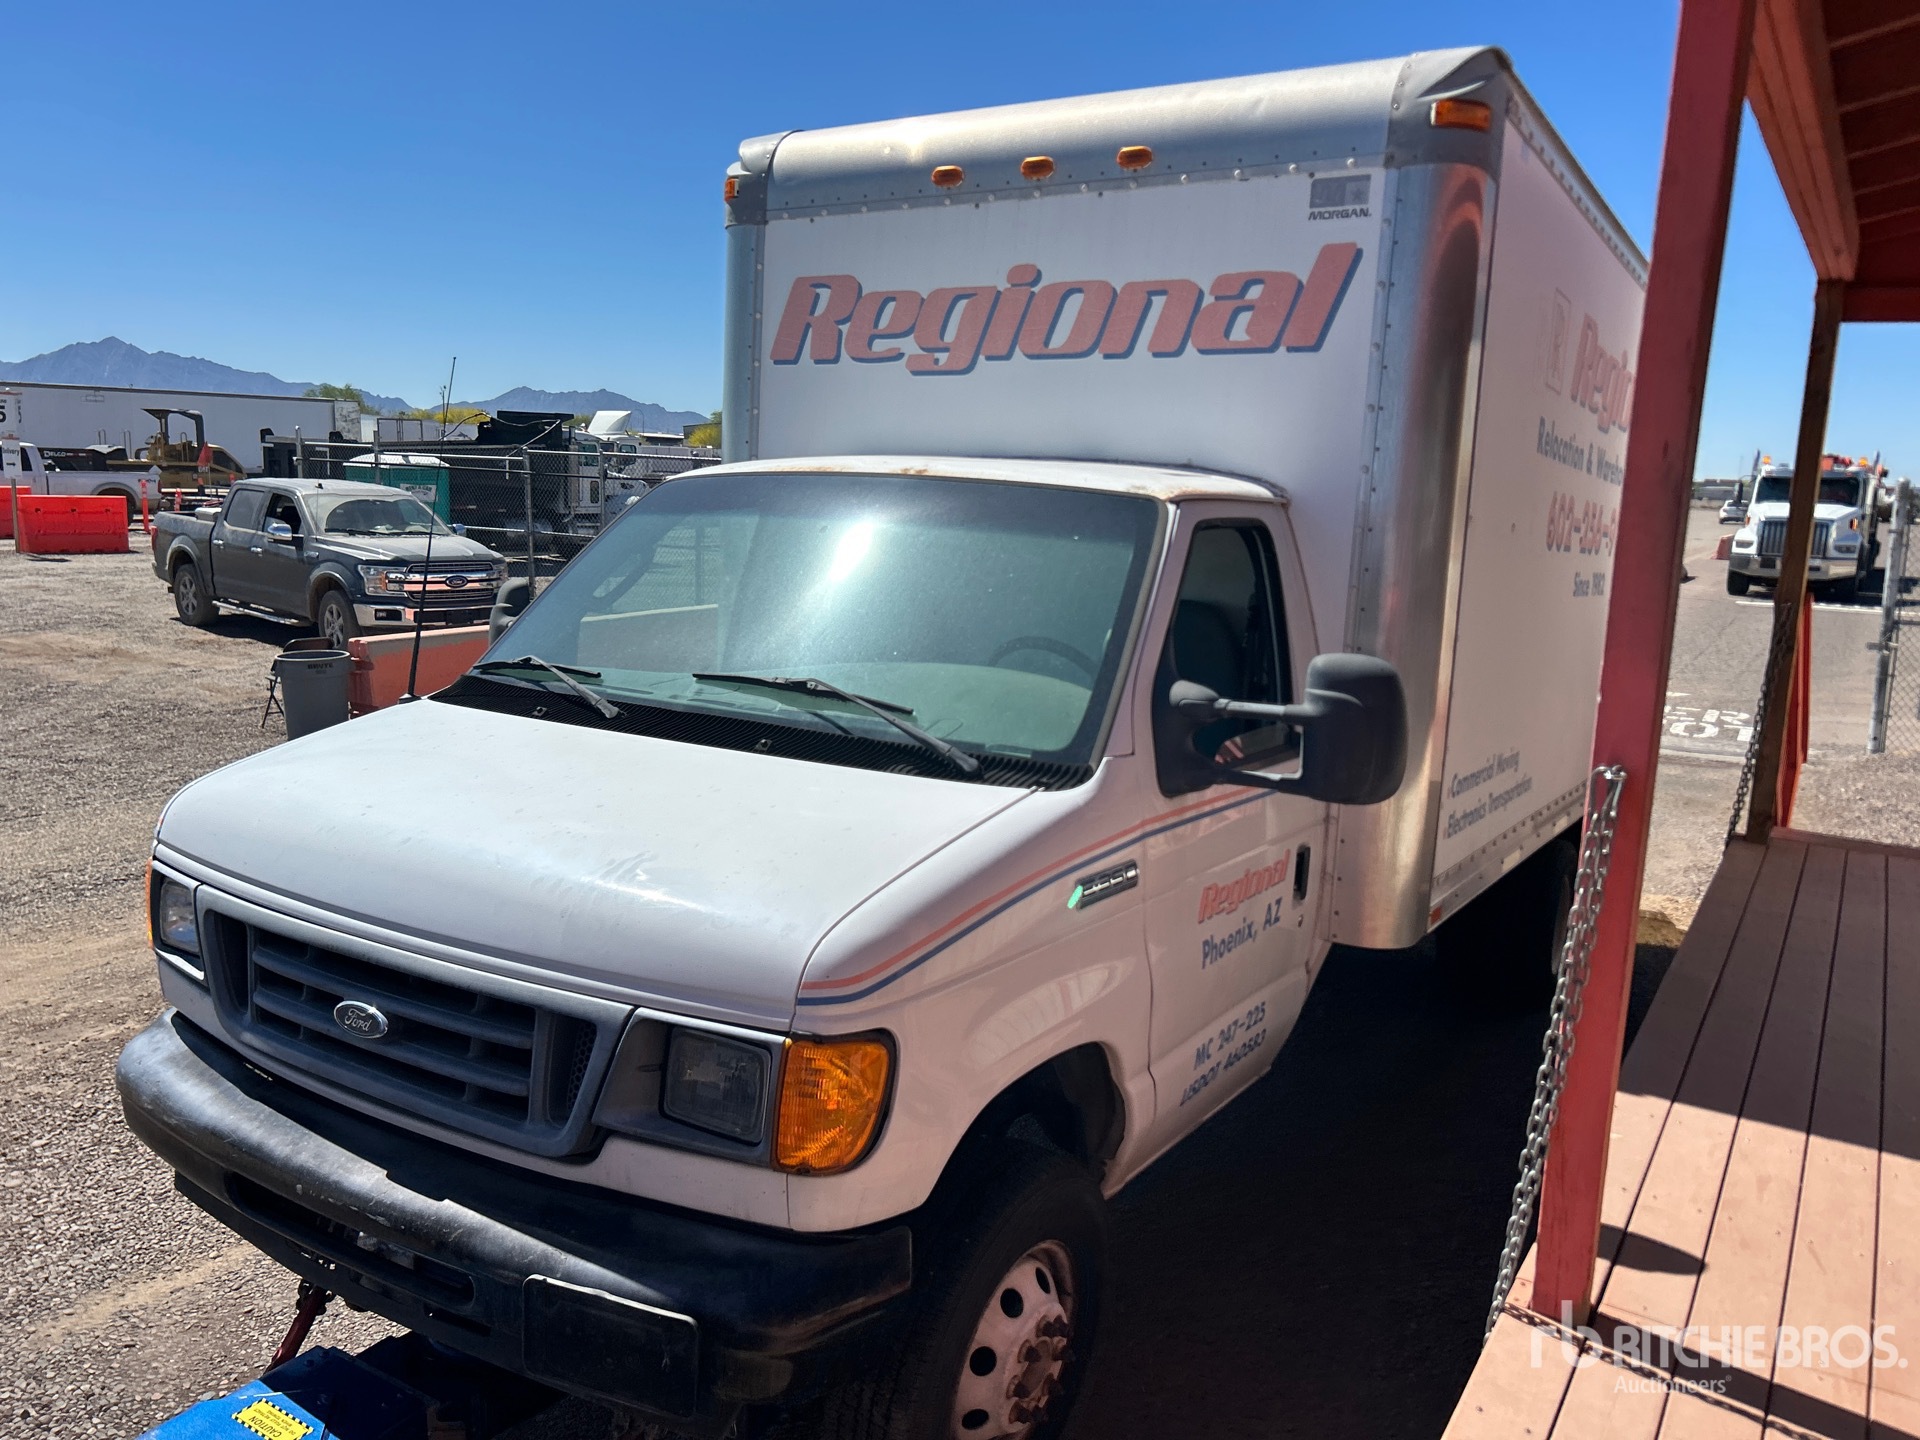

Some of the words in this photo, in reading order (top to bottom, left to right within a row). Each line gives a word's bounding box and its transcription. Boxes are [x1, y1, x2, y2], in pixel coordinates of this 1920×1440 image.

[1308, 207, 1371, 220] MORGAN
[769, 241, 1364, 376] Regional
[1197, 848, 1291, 925] Regional
[1201, 916, 1258, 970] Phoenix,
[1263, 896, 1283, 932] AZ
[344, 1008, 373, 1032] Ford
[1193, 1036, 1214, 1071] MC
[248, 1415, 282, 1438] CAUTION
